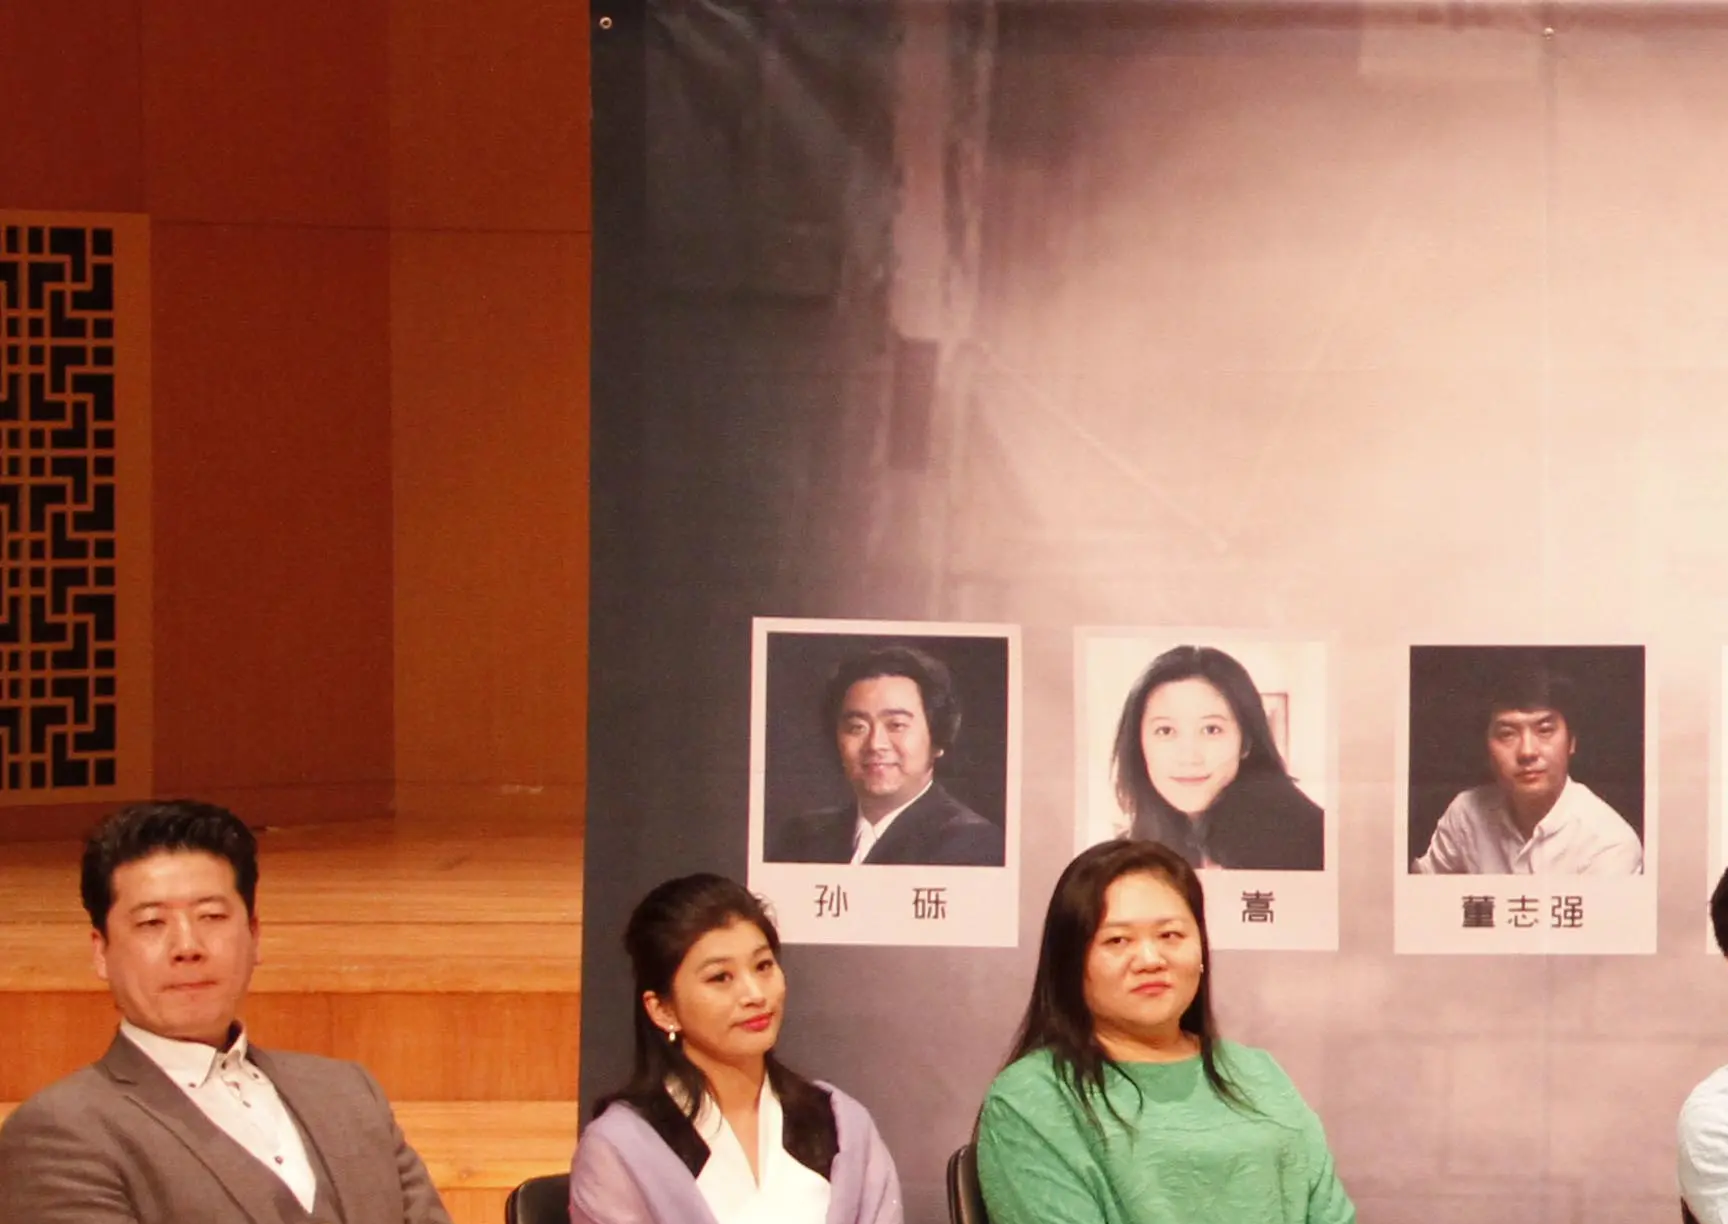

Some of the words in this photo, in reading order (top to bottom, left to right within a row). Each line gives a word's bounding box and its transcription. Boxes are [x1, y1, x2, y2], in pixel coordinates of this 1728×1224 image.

[813, 884, 948, 919] 孙砾
[1240, 889, 1276, 924] 嵩
[1461, 895, 1584, 930] 董志强
